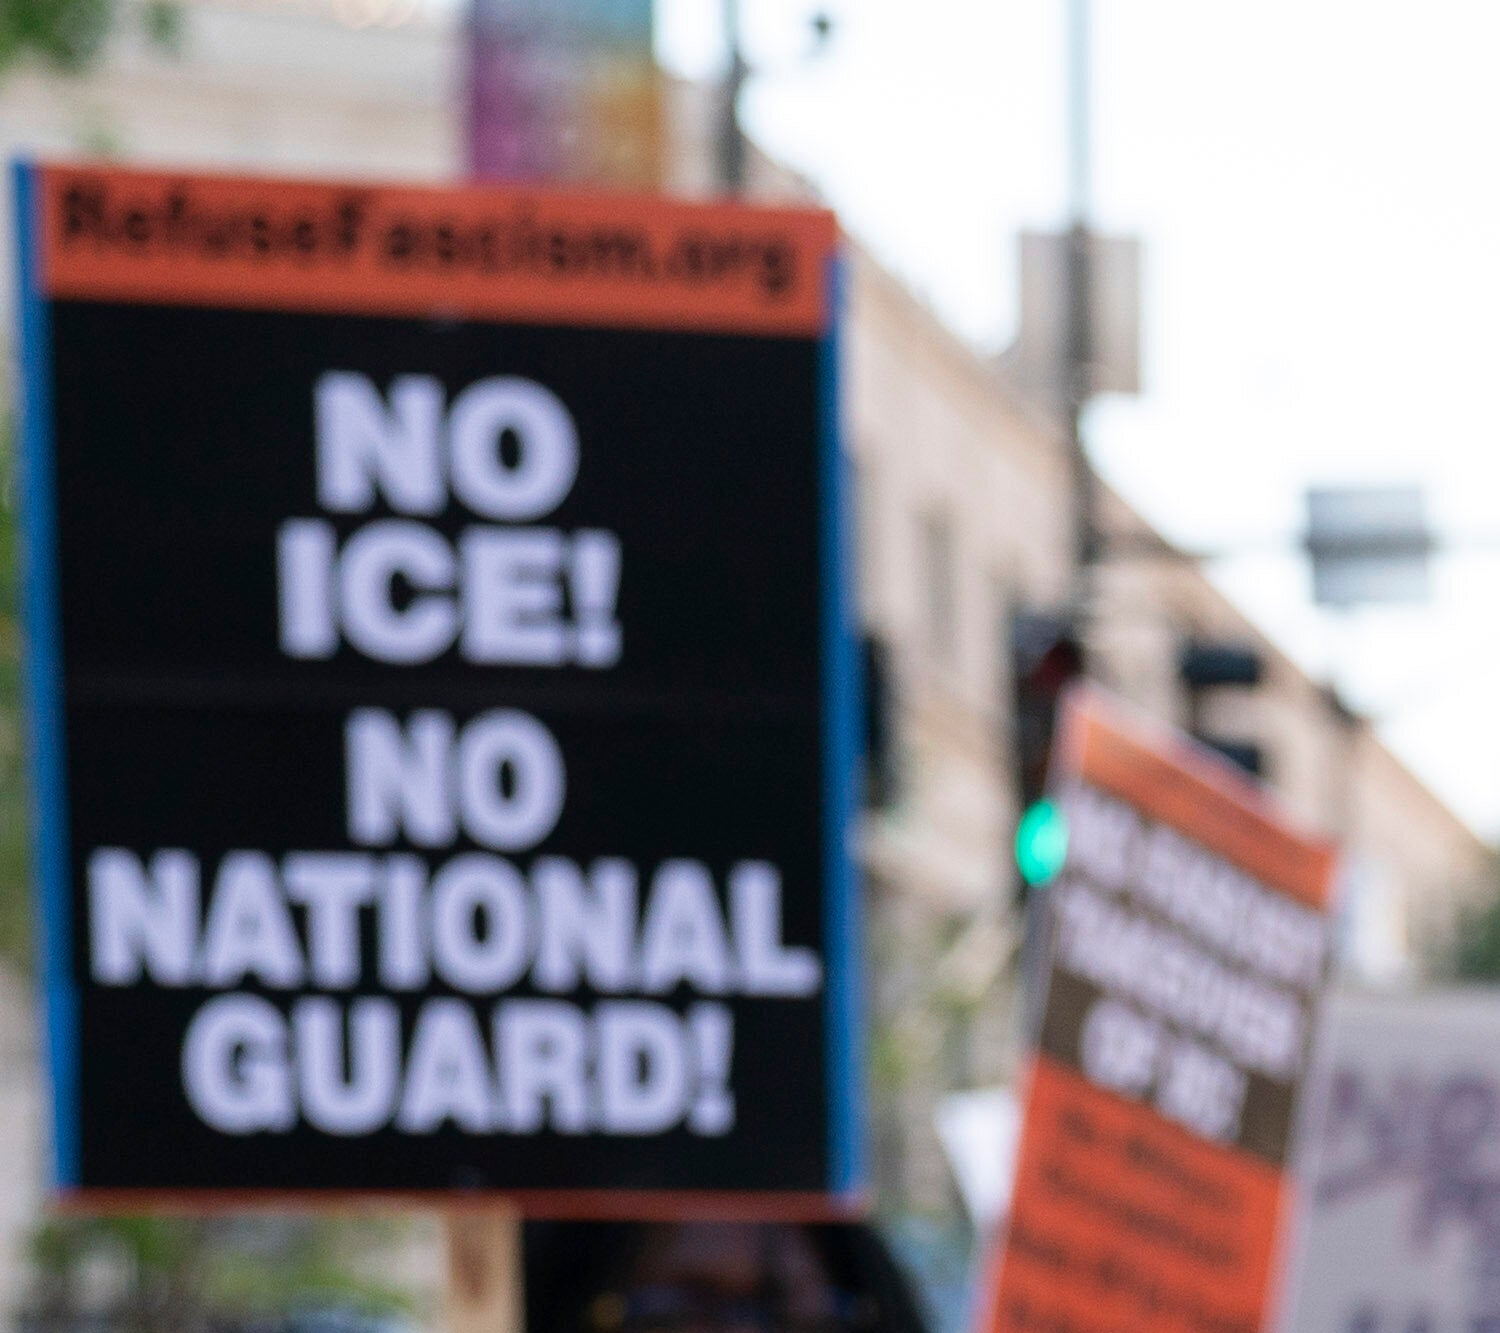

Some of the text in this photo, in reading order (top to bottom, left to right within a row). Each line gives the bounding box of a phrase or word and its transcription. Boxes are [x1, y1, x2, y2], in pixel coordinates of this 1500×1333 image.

[58, 185, 800, 299] RefuseFascism.org
[314, 371, 580, 520] NO
[276, 521, 623, 669] ICE!
[345, 708, 566, 851] NO
[86, 847, 822, 998] NATIONAL
[182, 996, 735, 1136] GUARD!
